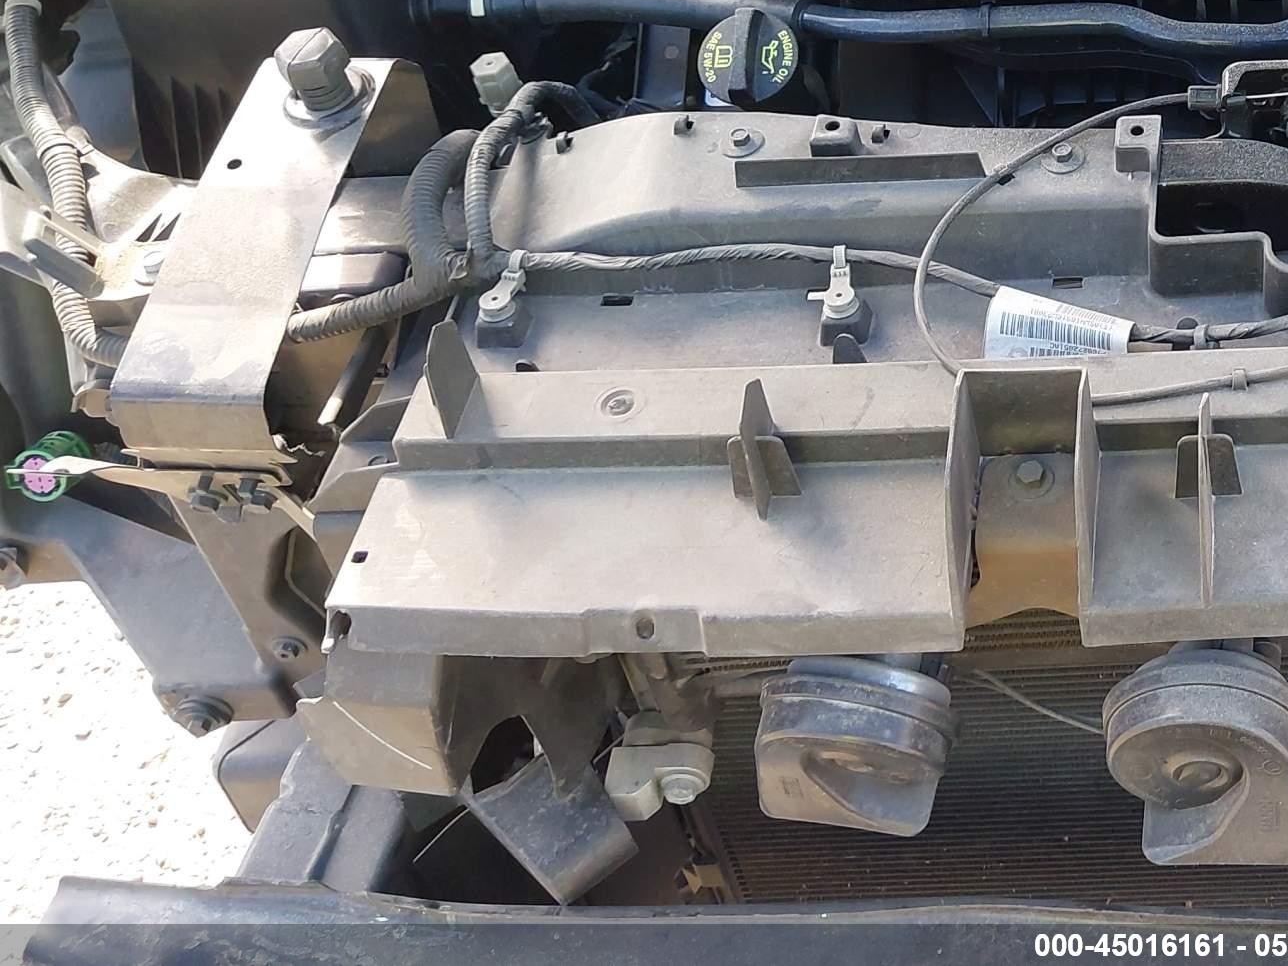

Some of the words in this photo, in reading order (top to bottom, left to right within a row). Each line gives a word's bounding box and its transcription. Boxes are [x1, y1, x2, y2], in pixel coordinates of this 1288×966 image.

[705, 31, 723, 51] SAE
[777, 29, 794, 67] ENGINE
[703, 52, 717, 83] 5W-20
[771, 68, 789, 84] OIL
